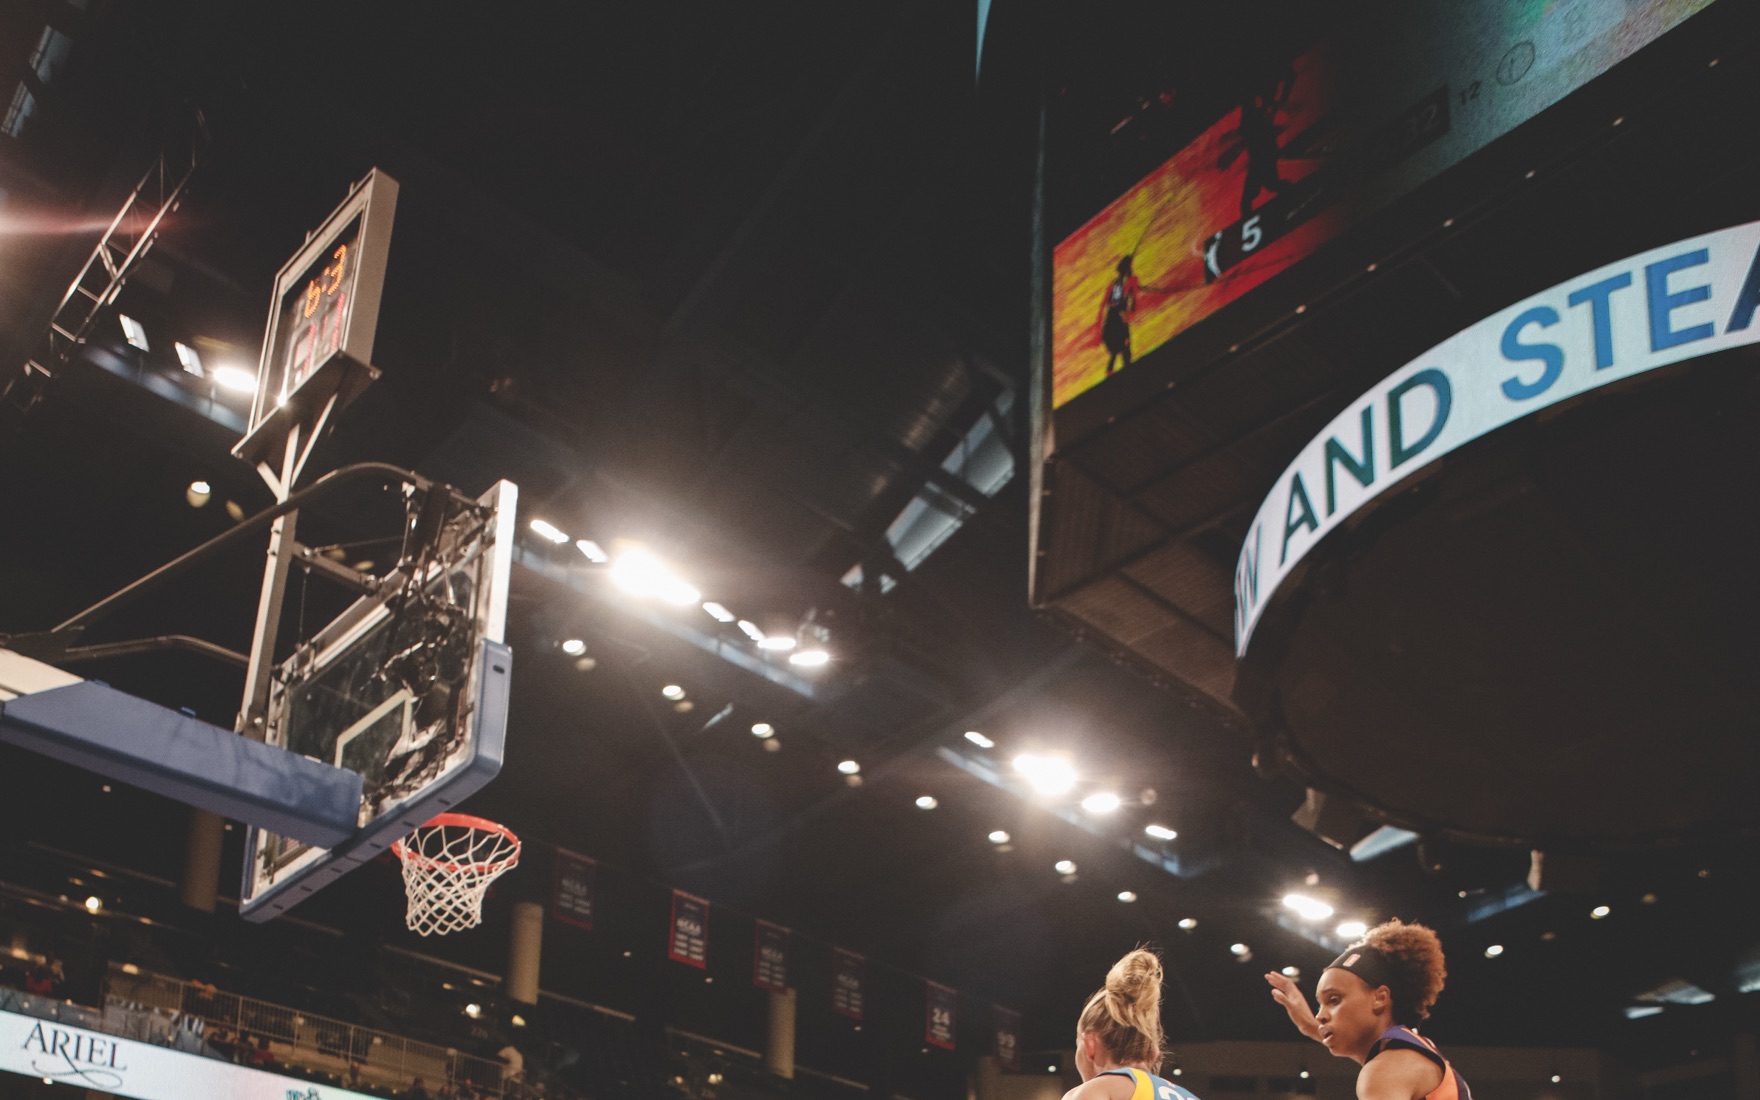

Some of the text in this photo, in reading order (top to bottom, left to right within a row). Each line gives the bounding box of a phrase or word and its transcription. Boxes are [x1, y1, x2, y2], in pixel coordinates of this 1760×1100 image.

[1241, 215, 1262, 252] 5
[1279, 367, 1452, 569] AND
[21, 1020, 127, 1076] ARIEL
